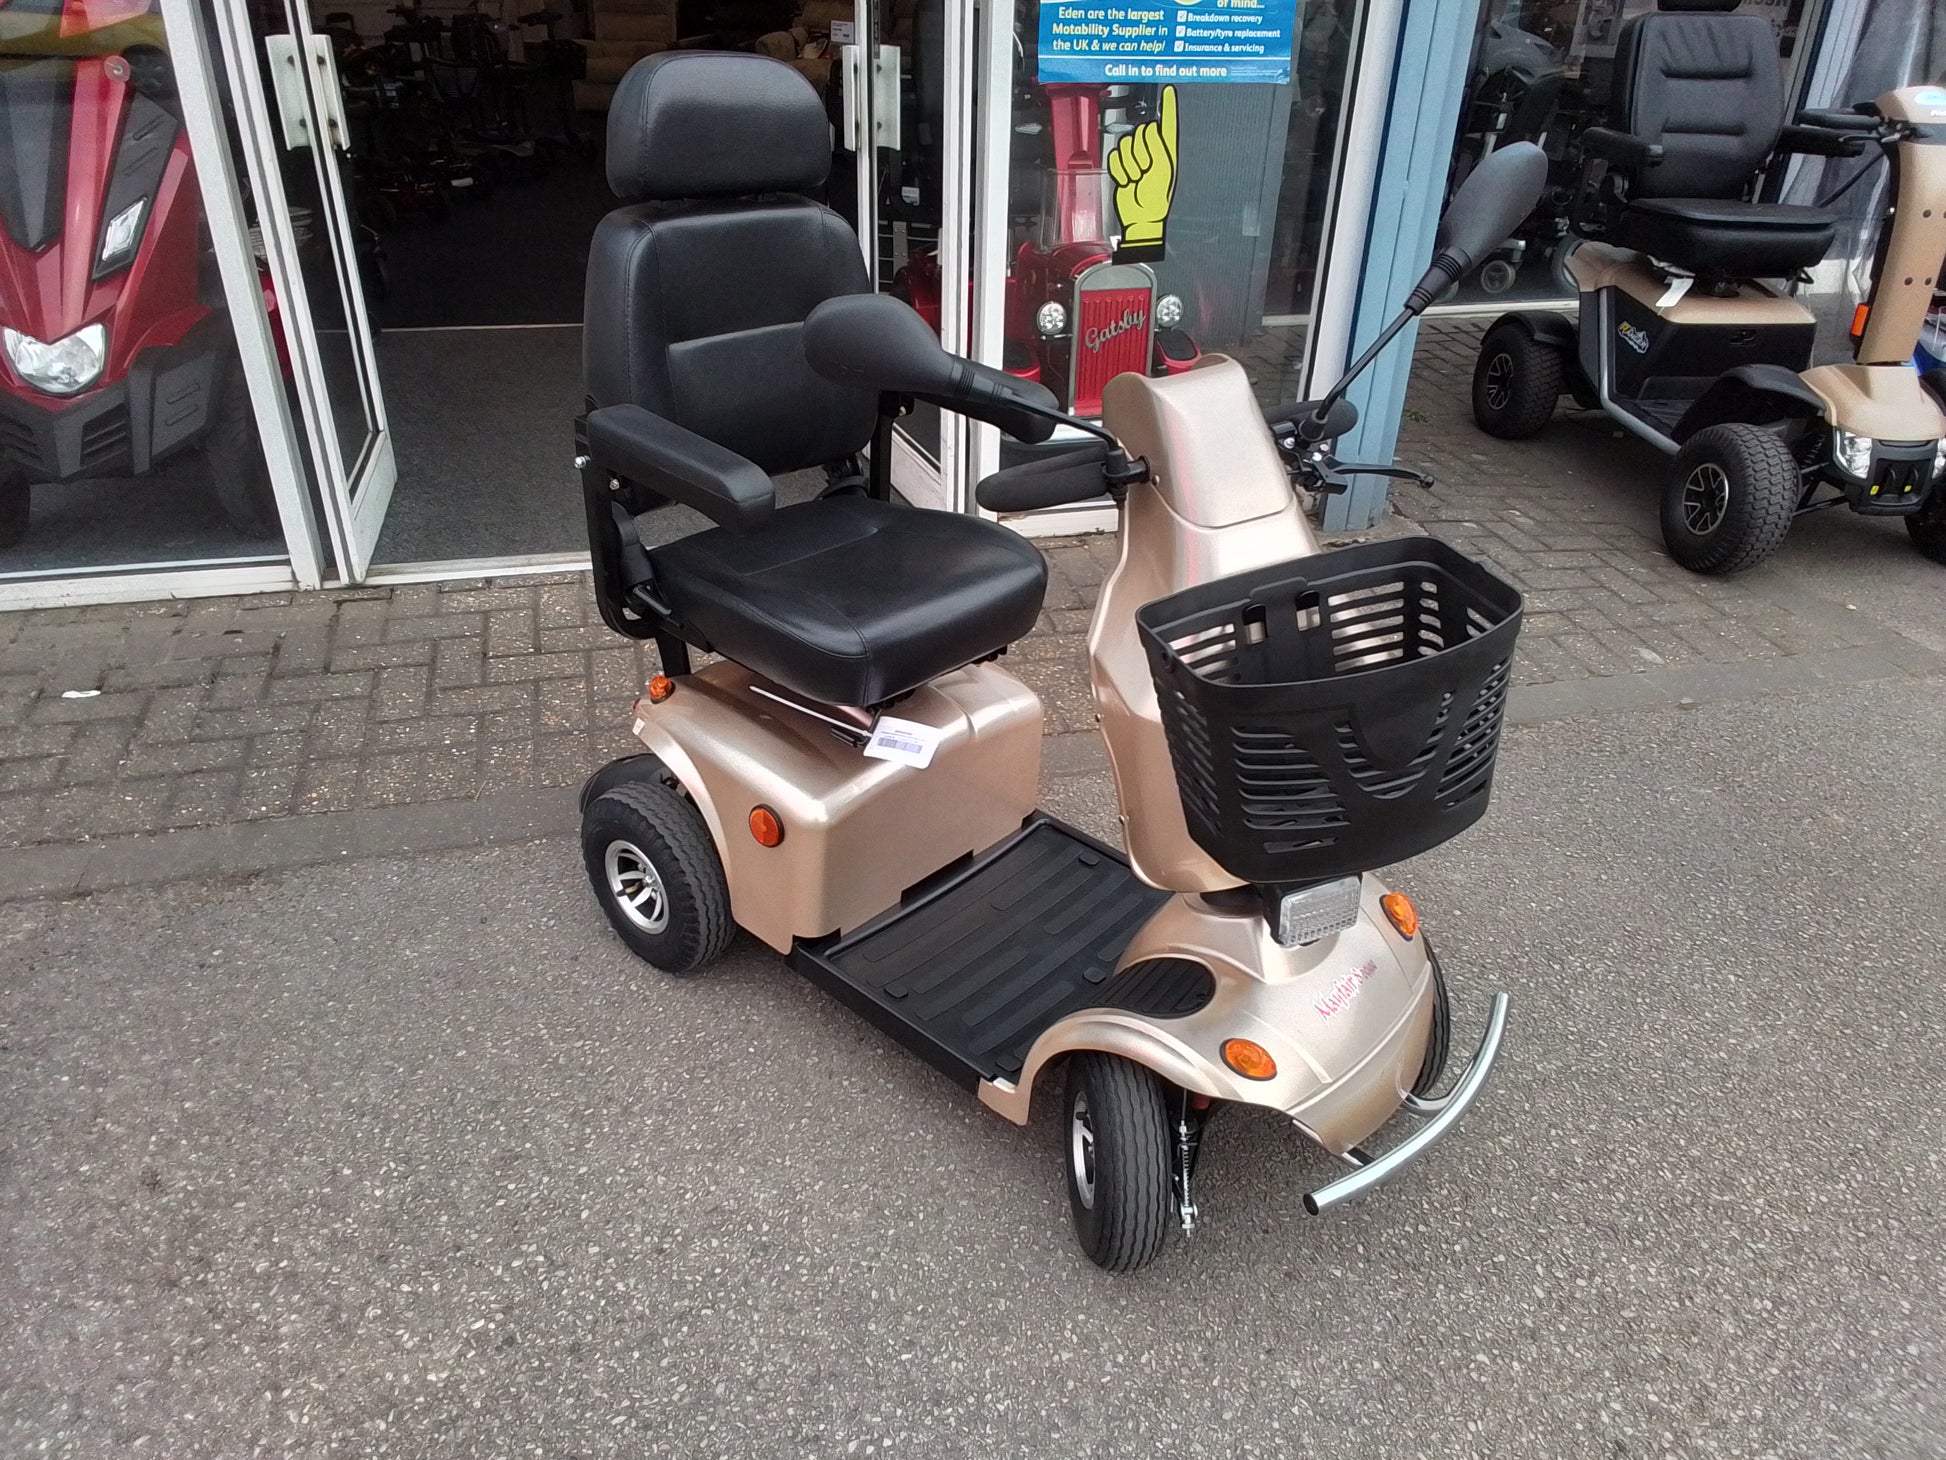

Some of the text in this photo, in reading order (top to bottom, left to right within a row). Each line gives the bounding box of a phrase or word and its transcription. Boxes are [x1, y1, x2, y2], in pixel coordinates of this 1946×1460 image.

[1058, 6, 1165, 23] Eden are the largest
[1187, 13, 1263, 24] Breakdown recovery
[1052, 23, 1168, 38] Motability Supplier in
[1186, 28, 1281, 39] Battery/tyre replacement
[1053, 39, 1166, 54] the UK & we can help!
[1184, 43, 1265, 54] Insurance & servicing
[1104, 64, 1126, 76] Call
[1128, 64, 1139, 76] in
[1141, 65, 1153, 76] to
[1155, 64, 1177, 76] find
[1178, 66, 1197, 76] out
[1199, 67, 1227, 76] more
[1084, 308, 1147, 354] Gatsby
[1312, 972, 1360, 1024] Mayfair
